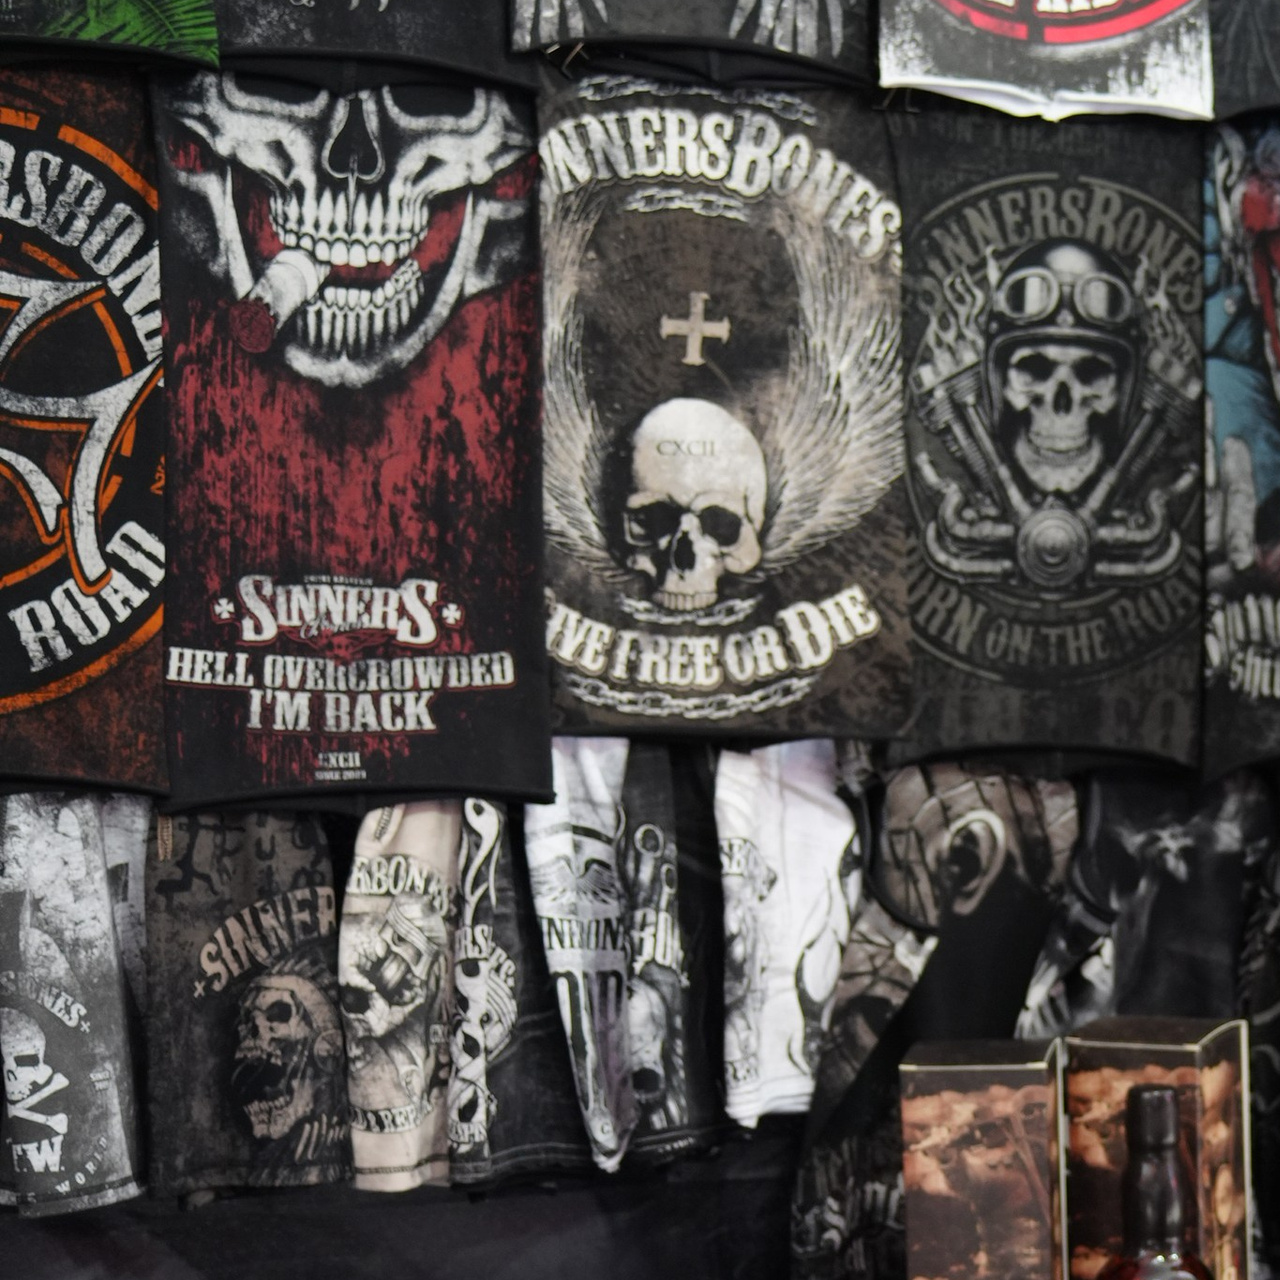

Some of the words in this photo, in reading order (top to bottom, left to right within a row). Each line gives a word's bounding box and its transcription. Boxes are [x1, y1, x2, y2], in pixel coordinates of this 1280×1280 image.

[7, 521, 165, 673] ROAD
[237, 575, 439, 646] SINNERS
[166, 646, 254, 687] HELL
[263, 650, 516, 692] OVERCROWDED
[613, 629, 720, 687] FREE
[723, 625, 788, 683] OR
[777, 584, 880, 671] DIE
[247, 688, 311, 732] I'M
[324, 689, 437, 733] BACK
